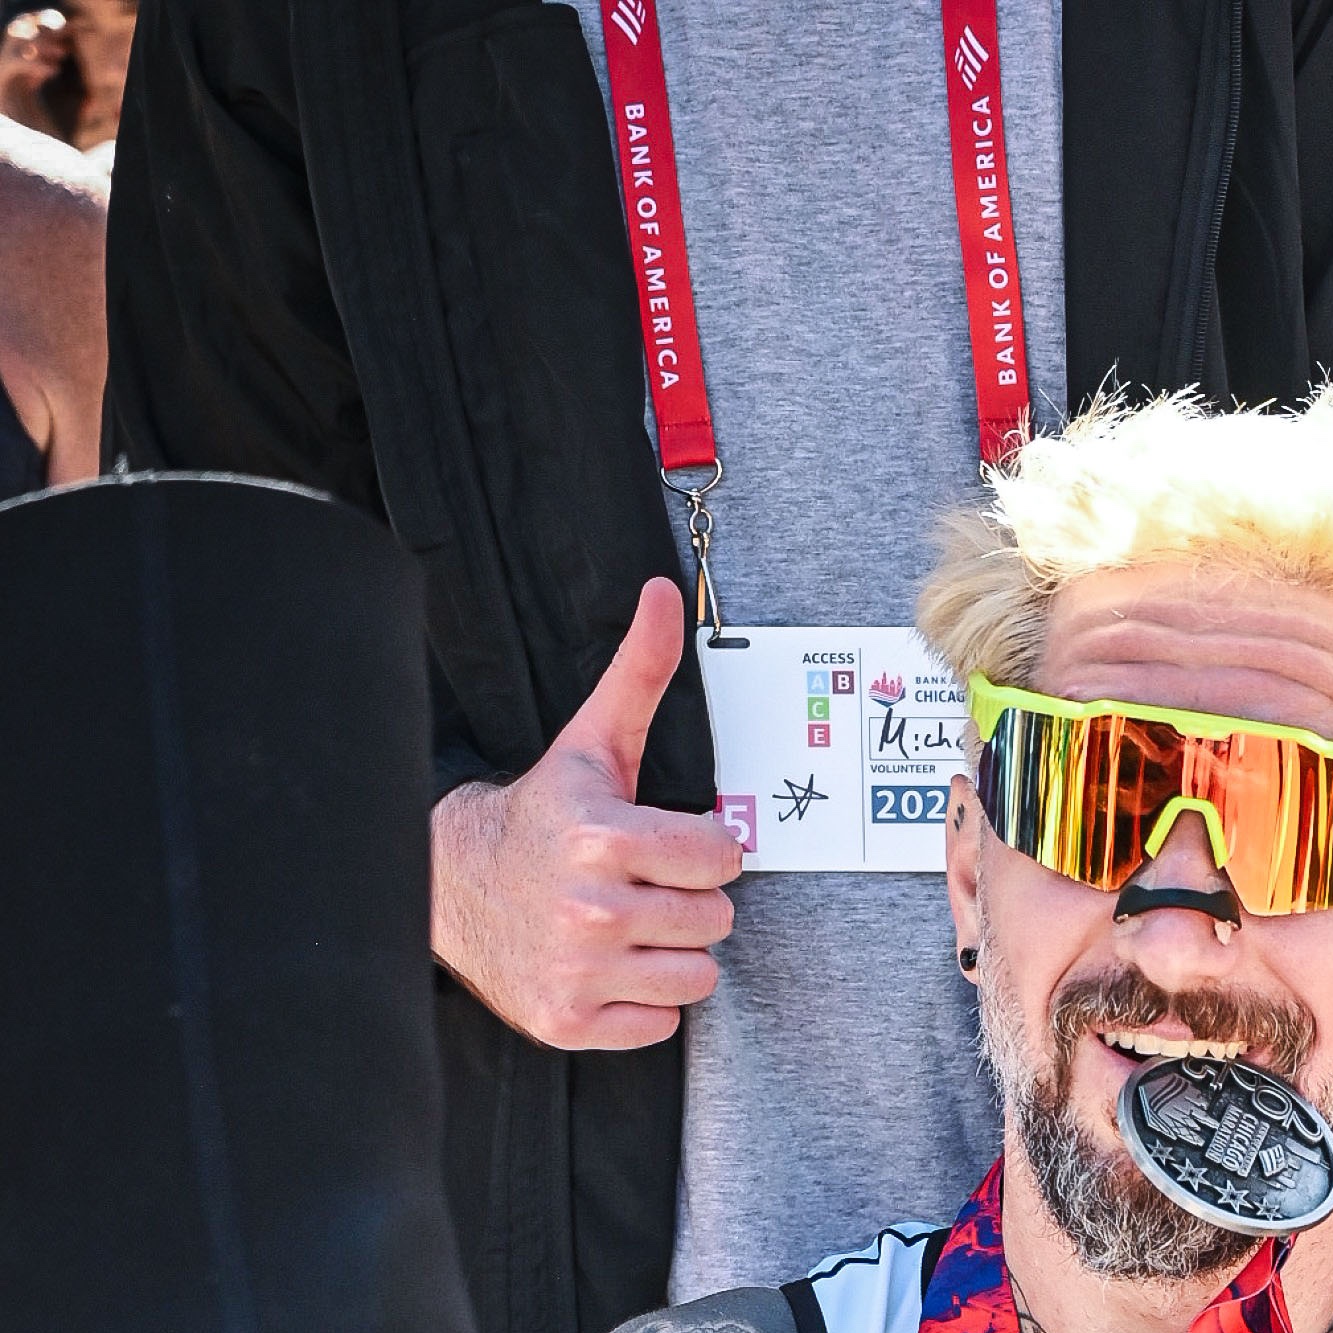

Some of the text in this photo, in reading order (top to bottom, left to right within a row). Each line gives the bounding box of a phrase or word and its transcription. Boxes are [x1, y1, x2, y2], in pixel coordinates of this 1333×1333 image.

[625, 103, 679, 390] BANK OF AMERICA
[972, 96, 1018, 386] BANK OF AMERICA
[802, 653, 855, 664] ACCESS
[811, 675, 850, 690] A B
[915, 676, 948, 685] BANK
[915, 690, 965, 703] CHICAG
[812, 702, 825, 717] C
[814, 729, 826, 744] E
[870, 764, 936, 774] VOLUNTEER
[875, 790, 946, 820] 202
[1205, 1104, 1243, 1163] MARATHON
[1221, 1112, 1260, 1172] CHICAGO
